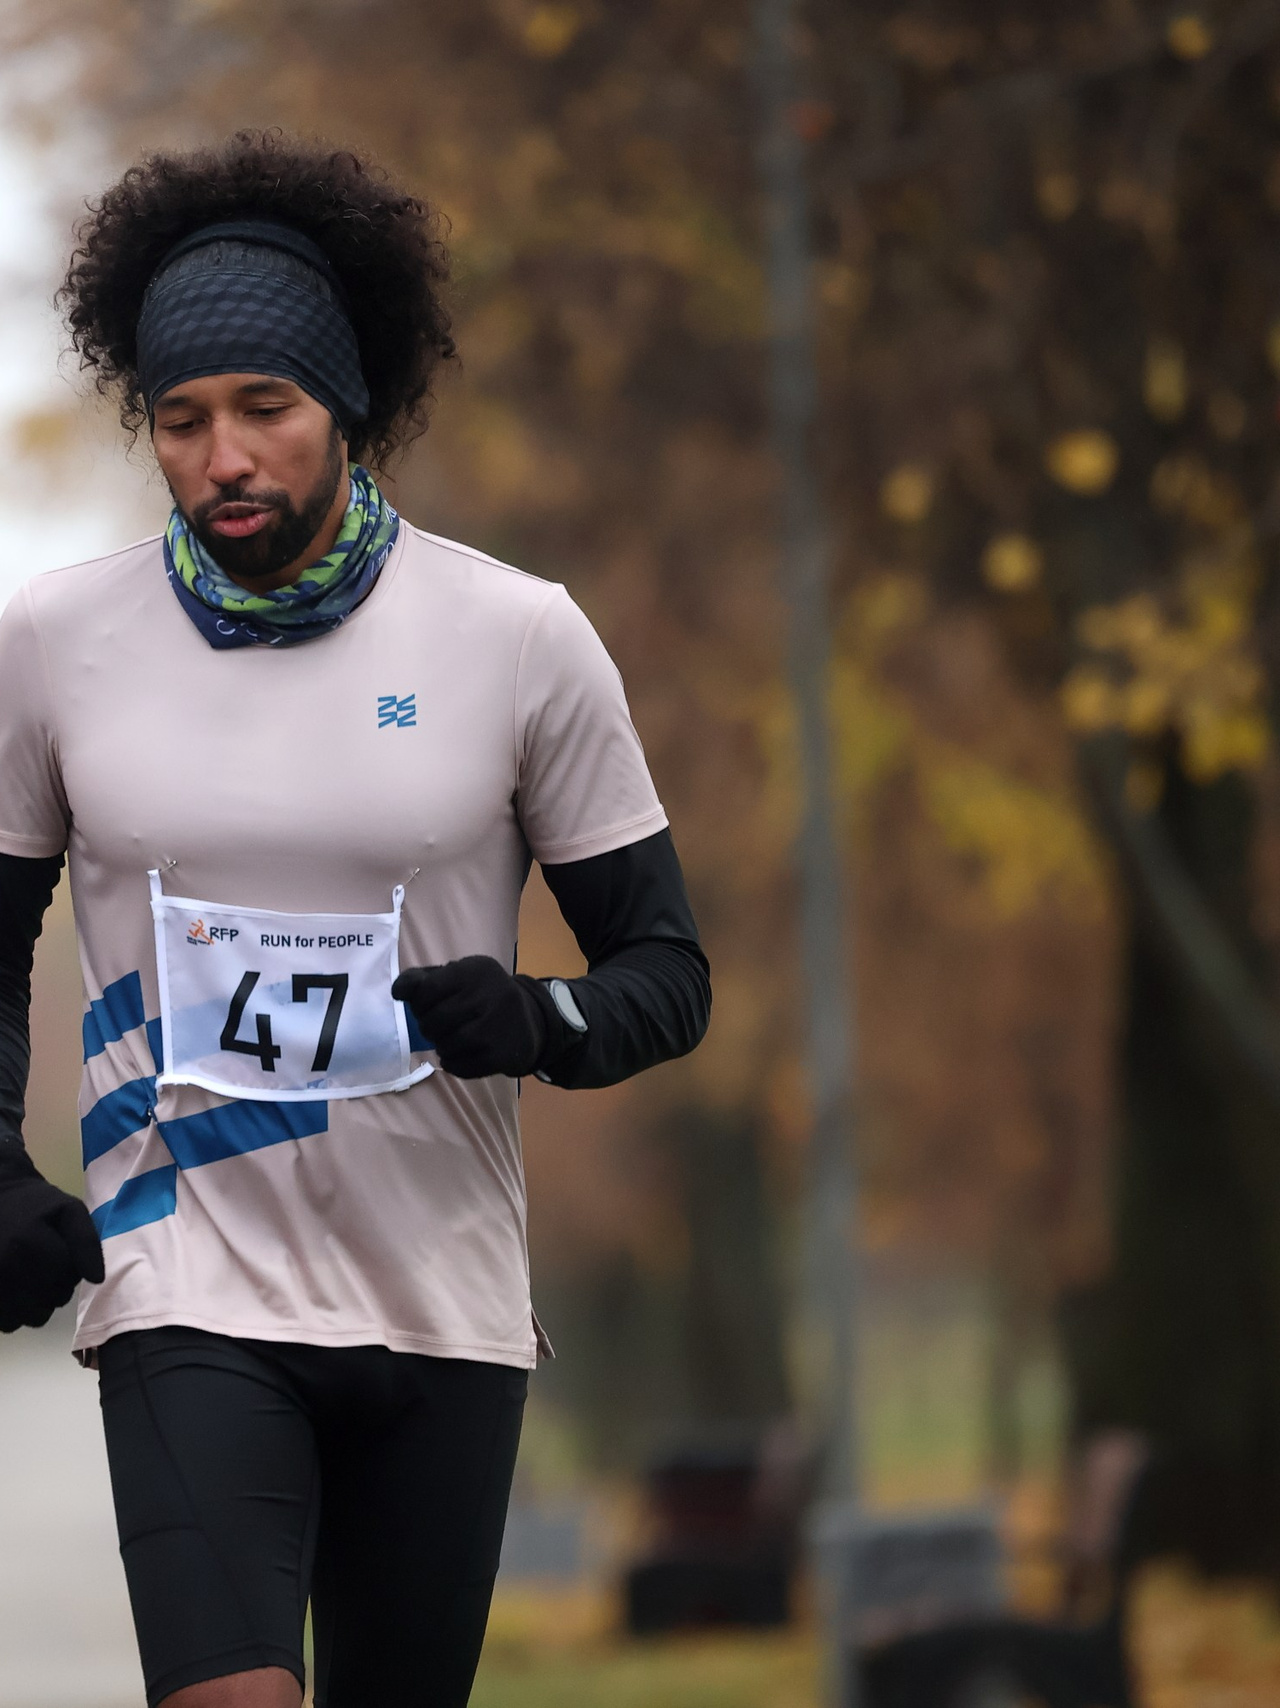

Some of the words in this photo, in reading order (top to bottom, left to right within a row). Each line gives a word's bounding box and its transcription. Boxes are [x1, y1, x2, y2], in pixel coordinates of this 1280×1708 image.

[209, 926, 239, 942] RFP
[260, 934, 291, 948] RUN
[294, 935, 315, 948] for
[318, 934, 374, 948] PEOPLE
[220, 971, 349, 1073] 47
